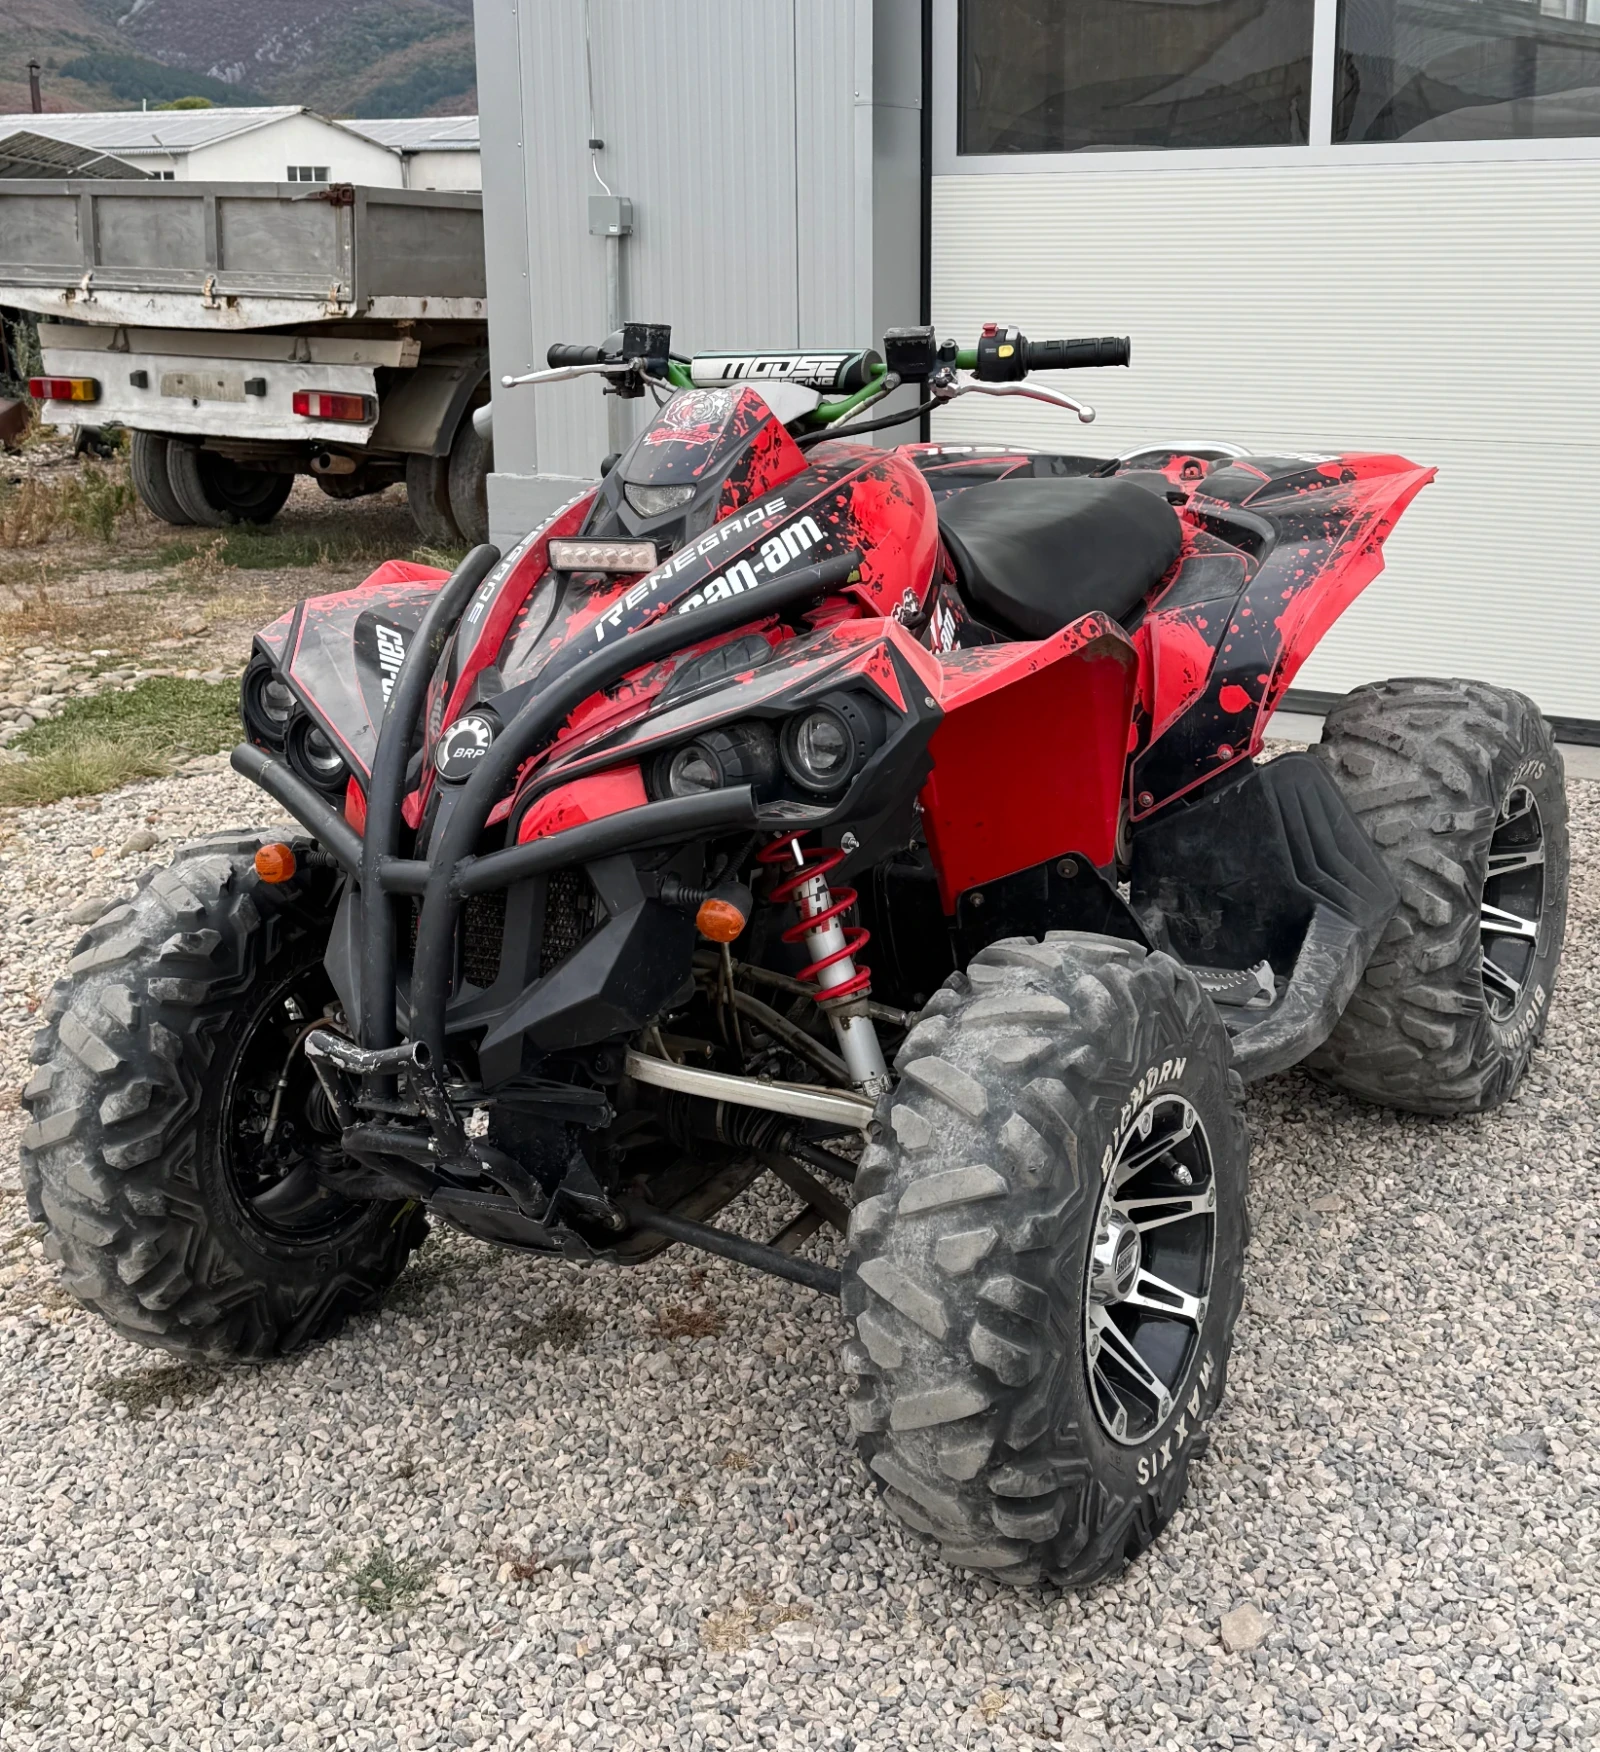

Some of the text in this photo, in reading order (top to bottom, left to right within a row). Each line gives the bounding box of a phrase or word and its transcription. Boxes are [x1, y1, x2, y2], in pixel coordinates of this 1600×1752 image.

[721, 355, 848, 379] MOOSE
[594, 496, 788, 642] RENEGADE
[375, 624, 405, 709] can-a
[452, 747, 486, 759] BRP
[1136, 1350, 1215, 1486] MAXXIS
